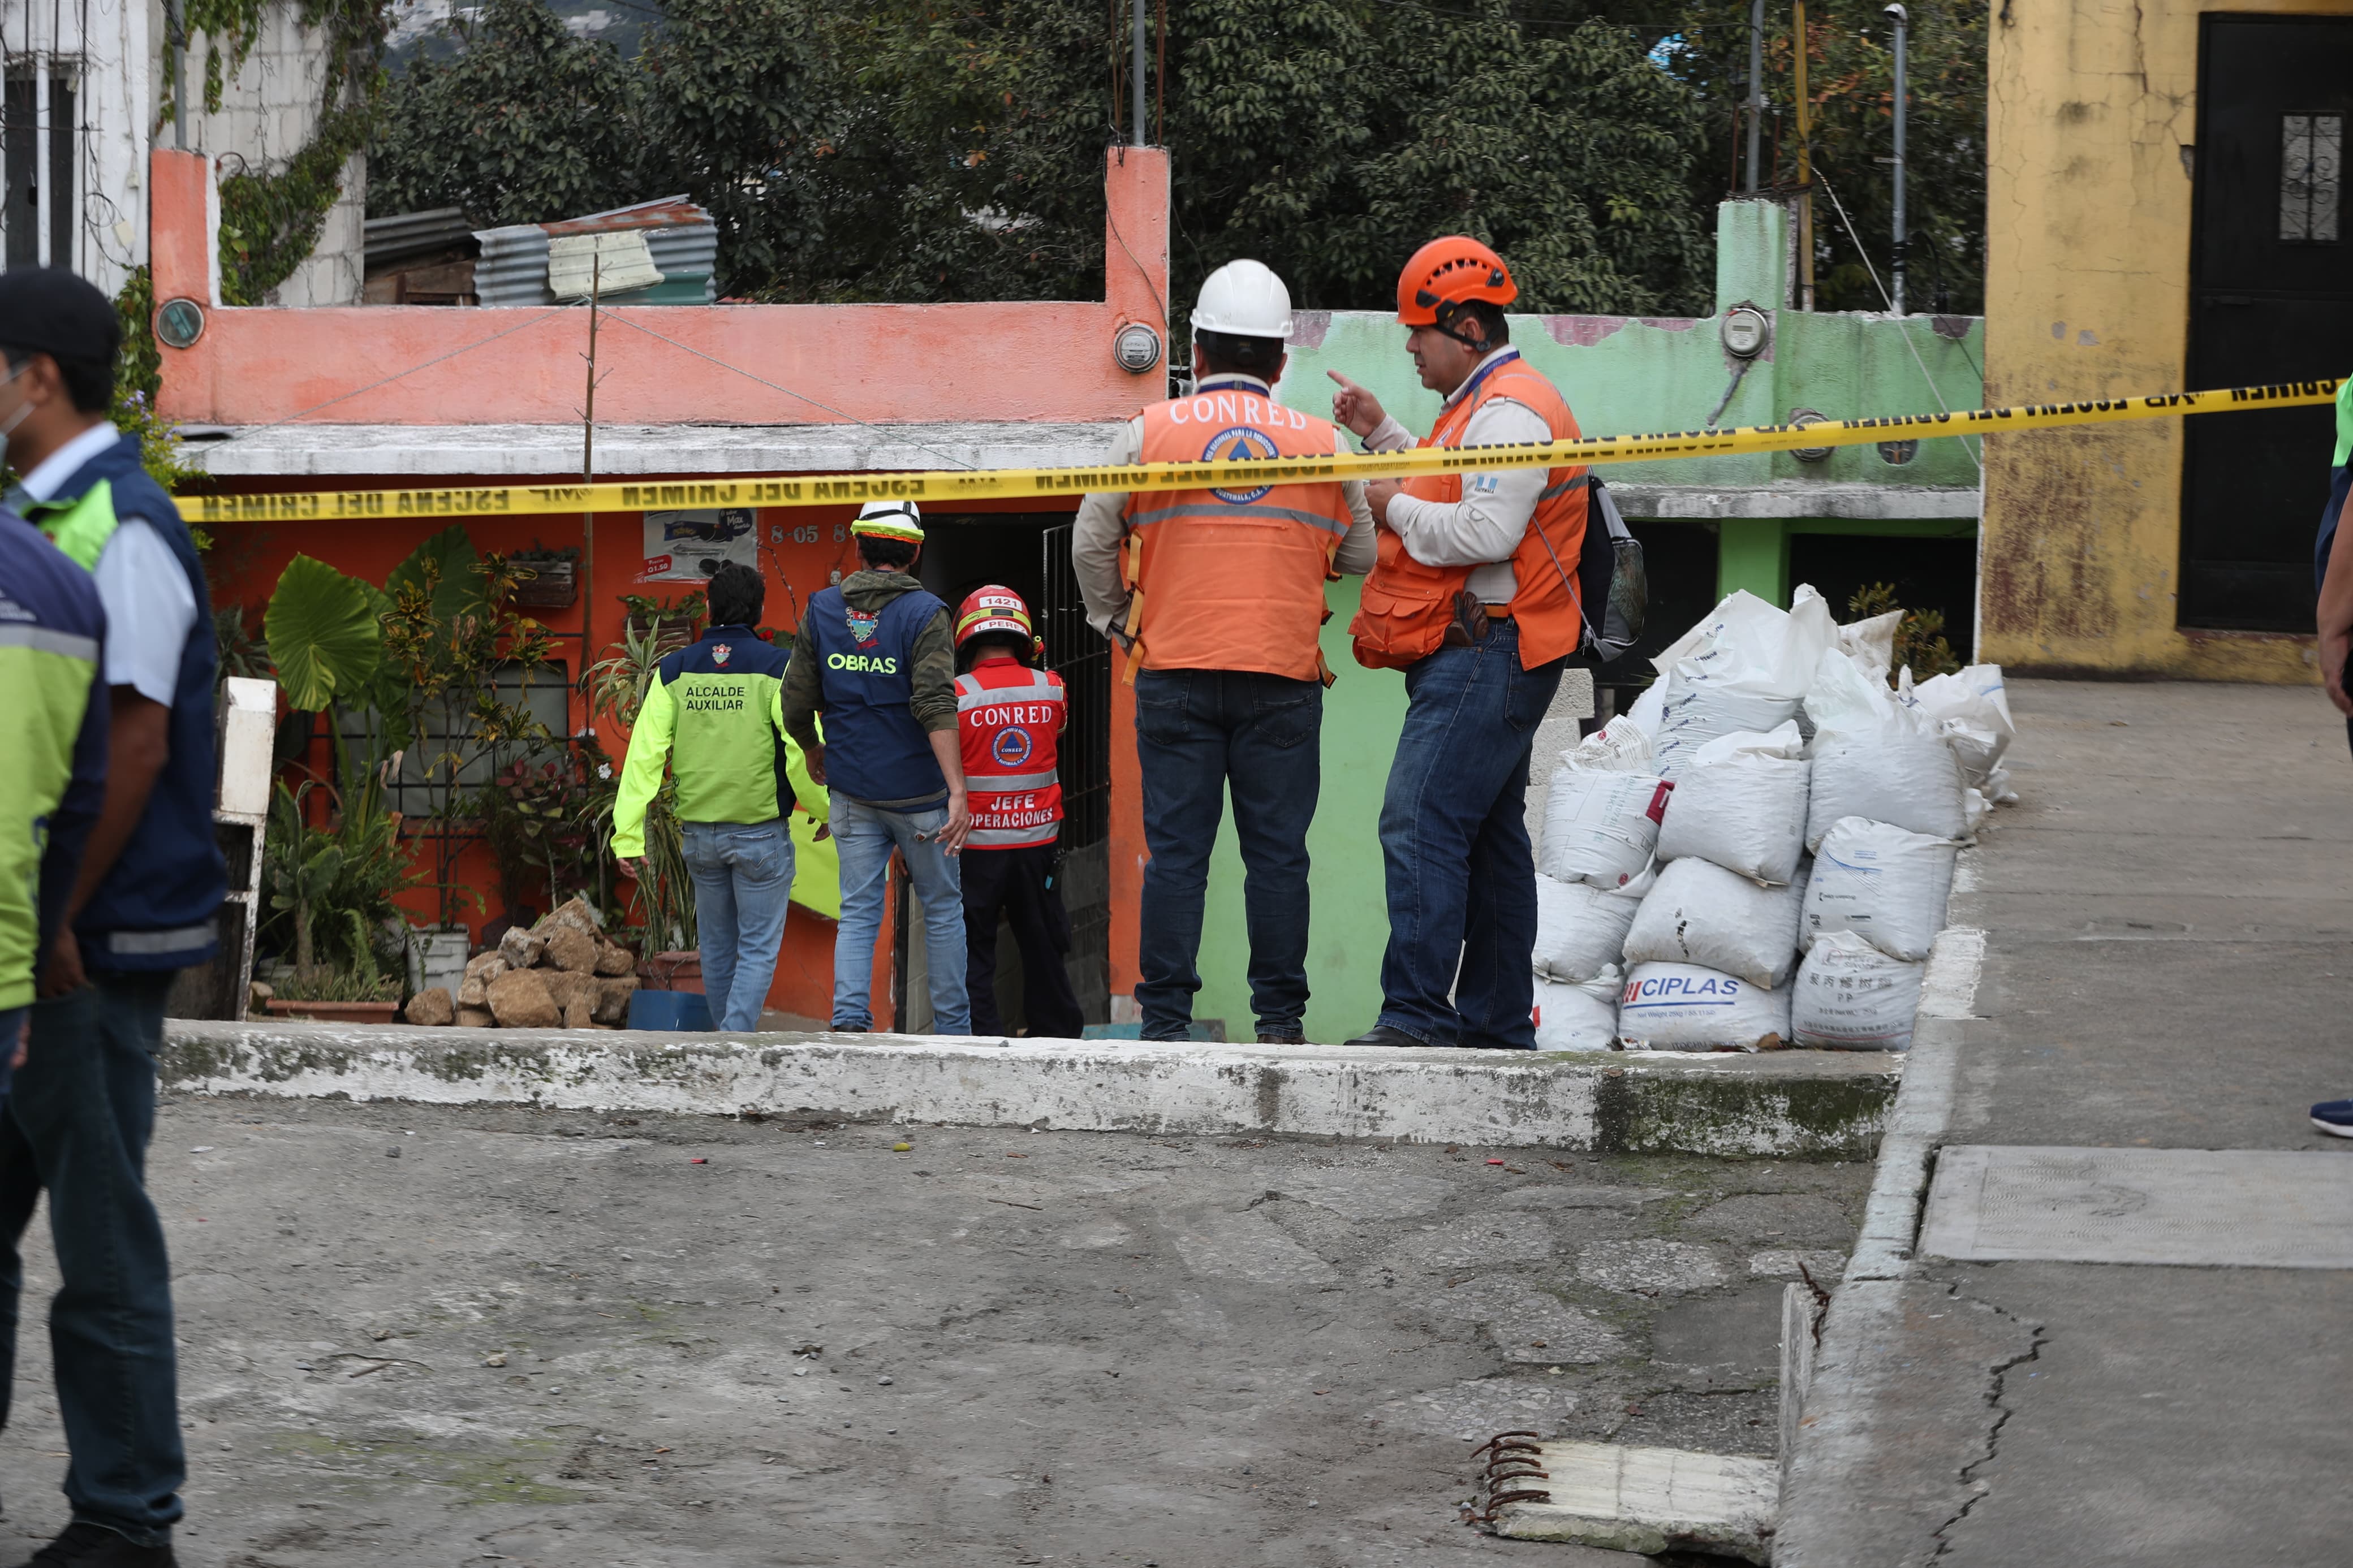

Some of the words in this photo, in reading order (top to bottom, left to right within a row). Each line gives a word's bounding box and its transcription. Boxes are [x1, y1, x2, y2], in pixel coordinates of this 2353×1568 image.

[1170, 394, 1307, 430] CONRED
[771, 525, 818, 543] 8-05
[648, 563, 668, 573] Q1.50
[986, 598, 1017, 607] 1421
[828, 653, 896, 674] OBRAS
[686, 686, 744, 697] ALCALDE
[686, 699, 743, 710] AUXILIAR
[971, 706, 1051, 727] CONRED
[991, 794, 1035, 811] JEFE
[968, 807, 1053, 827] OPERACIONES
[1643, 977, 1739, 996] CIPLAS
